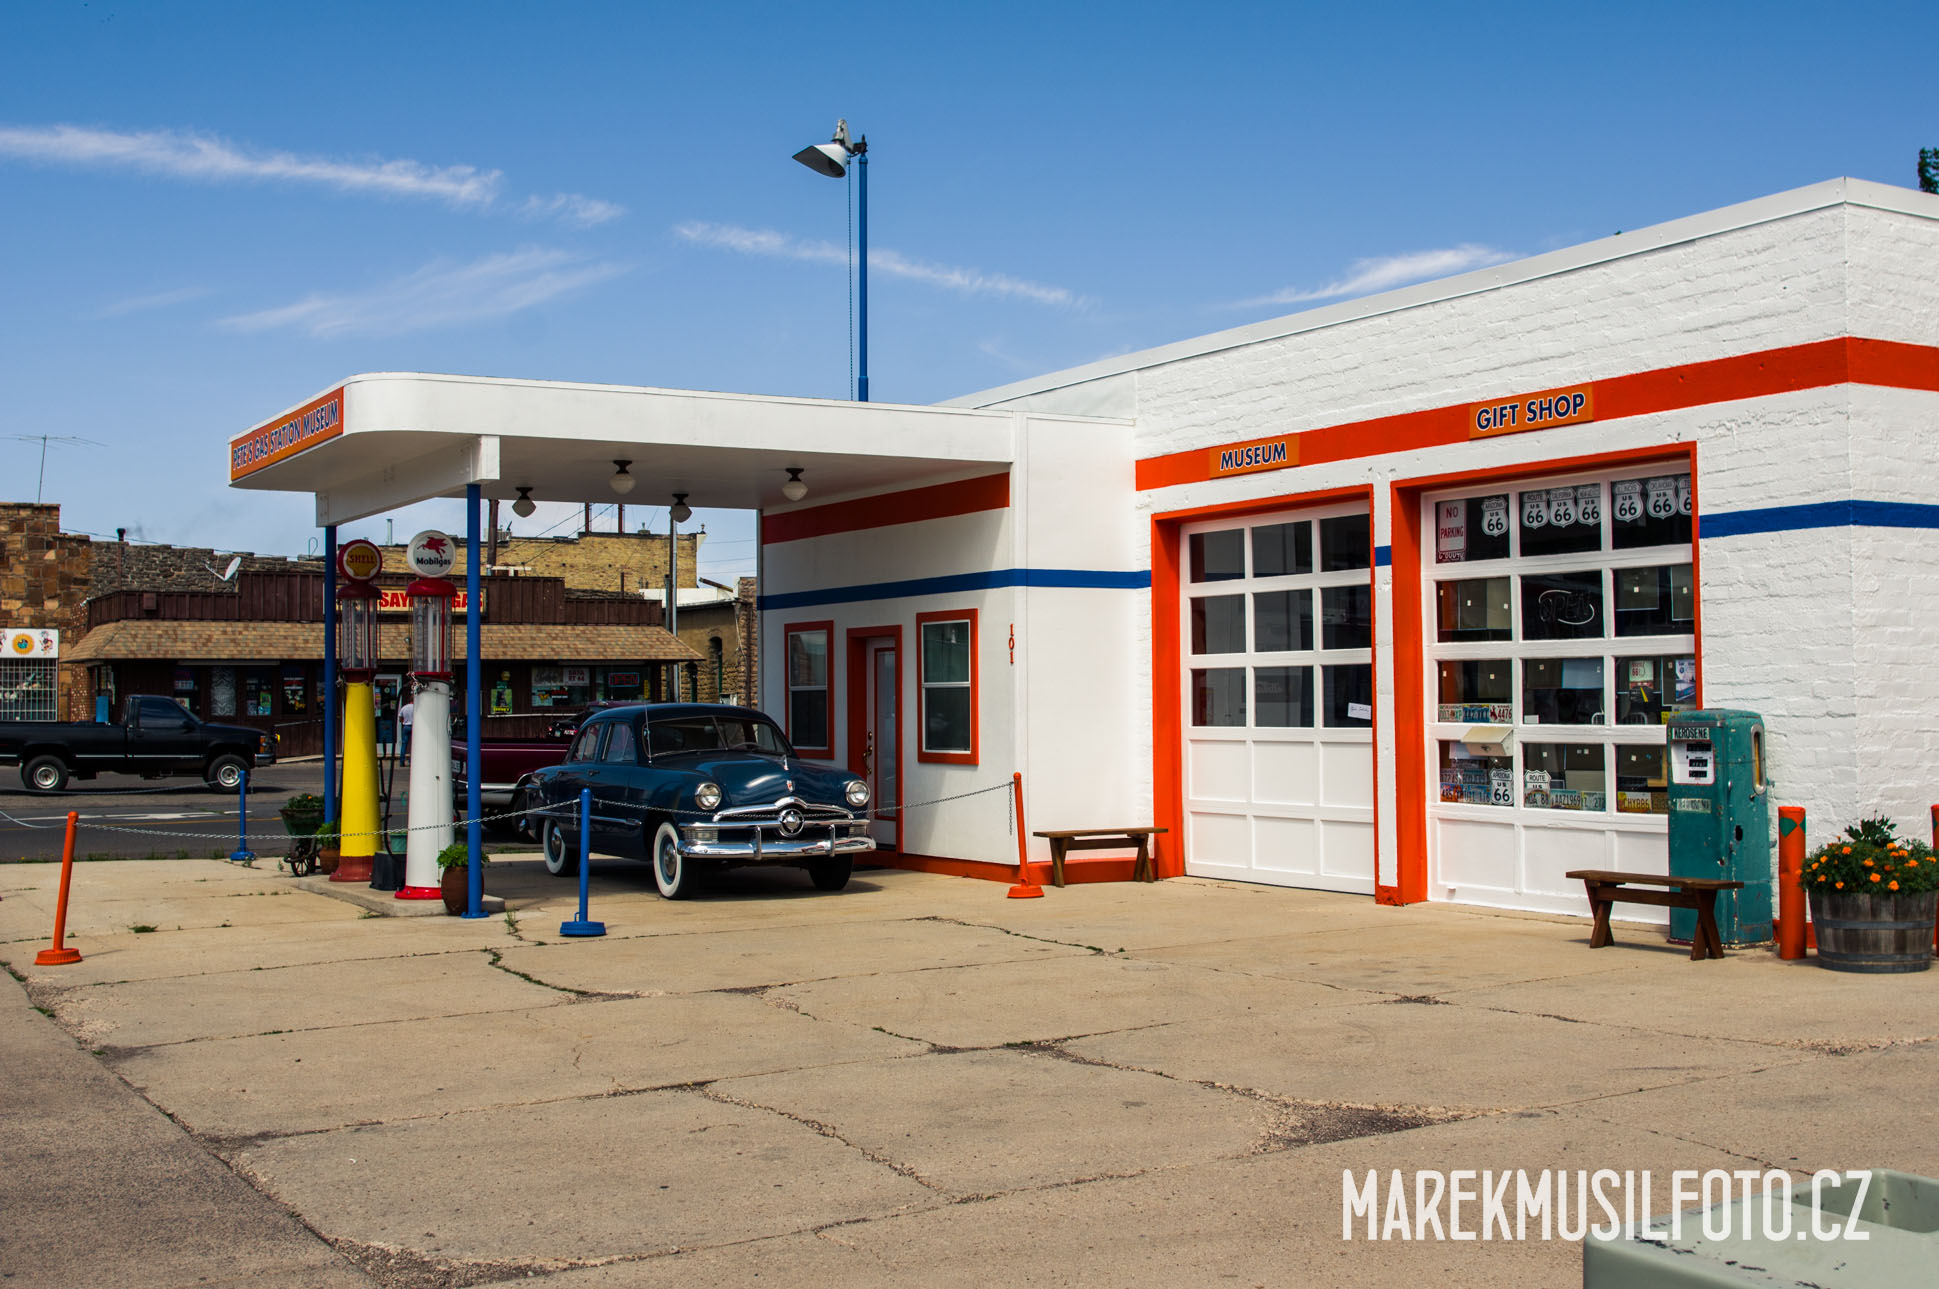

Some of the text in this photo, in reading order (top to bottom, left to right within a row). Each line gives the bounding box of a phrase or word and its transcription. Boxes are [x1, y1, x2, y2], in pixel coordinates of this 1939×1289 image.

[1476, 392, 1586, 432] GIFT SHOP
[233, 399, 339, 471] PETE'S GAS STATION MUSEUM
[1220, 441, 1287, 472] MUSEUM
[1446, 506, 1459, 519] NO
[1582, 505, 1600, 520] 66
[1618, 502, 1637, 517] 66
[1653, 498, 1672, 514] 66
[1527, 510, 1544, 524] 66
[1554, 507, 1572, 522] 66
[1487, 517, 1504, 532] 66
[1441, 526, 1464, 540] PARKING
[349, 554, 375, 564] SHELL
[416, 556, 451, 567] Mobilgas
[1674, 728, 1708, 739] KEROSENE
[1493, 788, 1510, 802] 66
